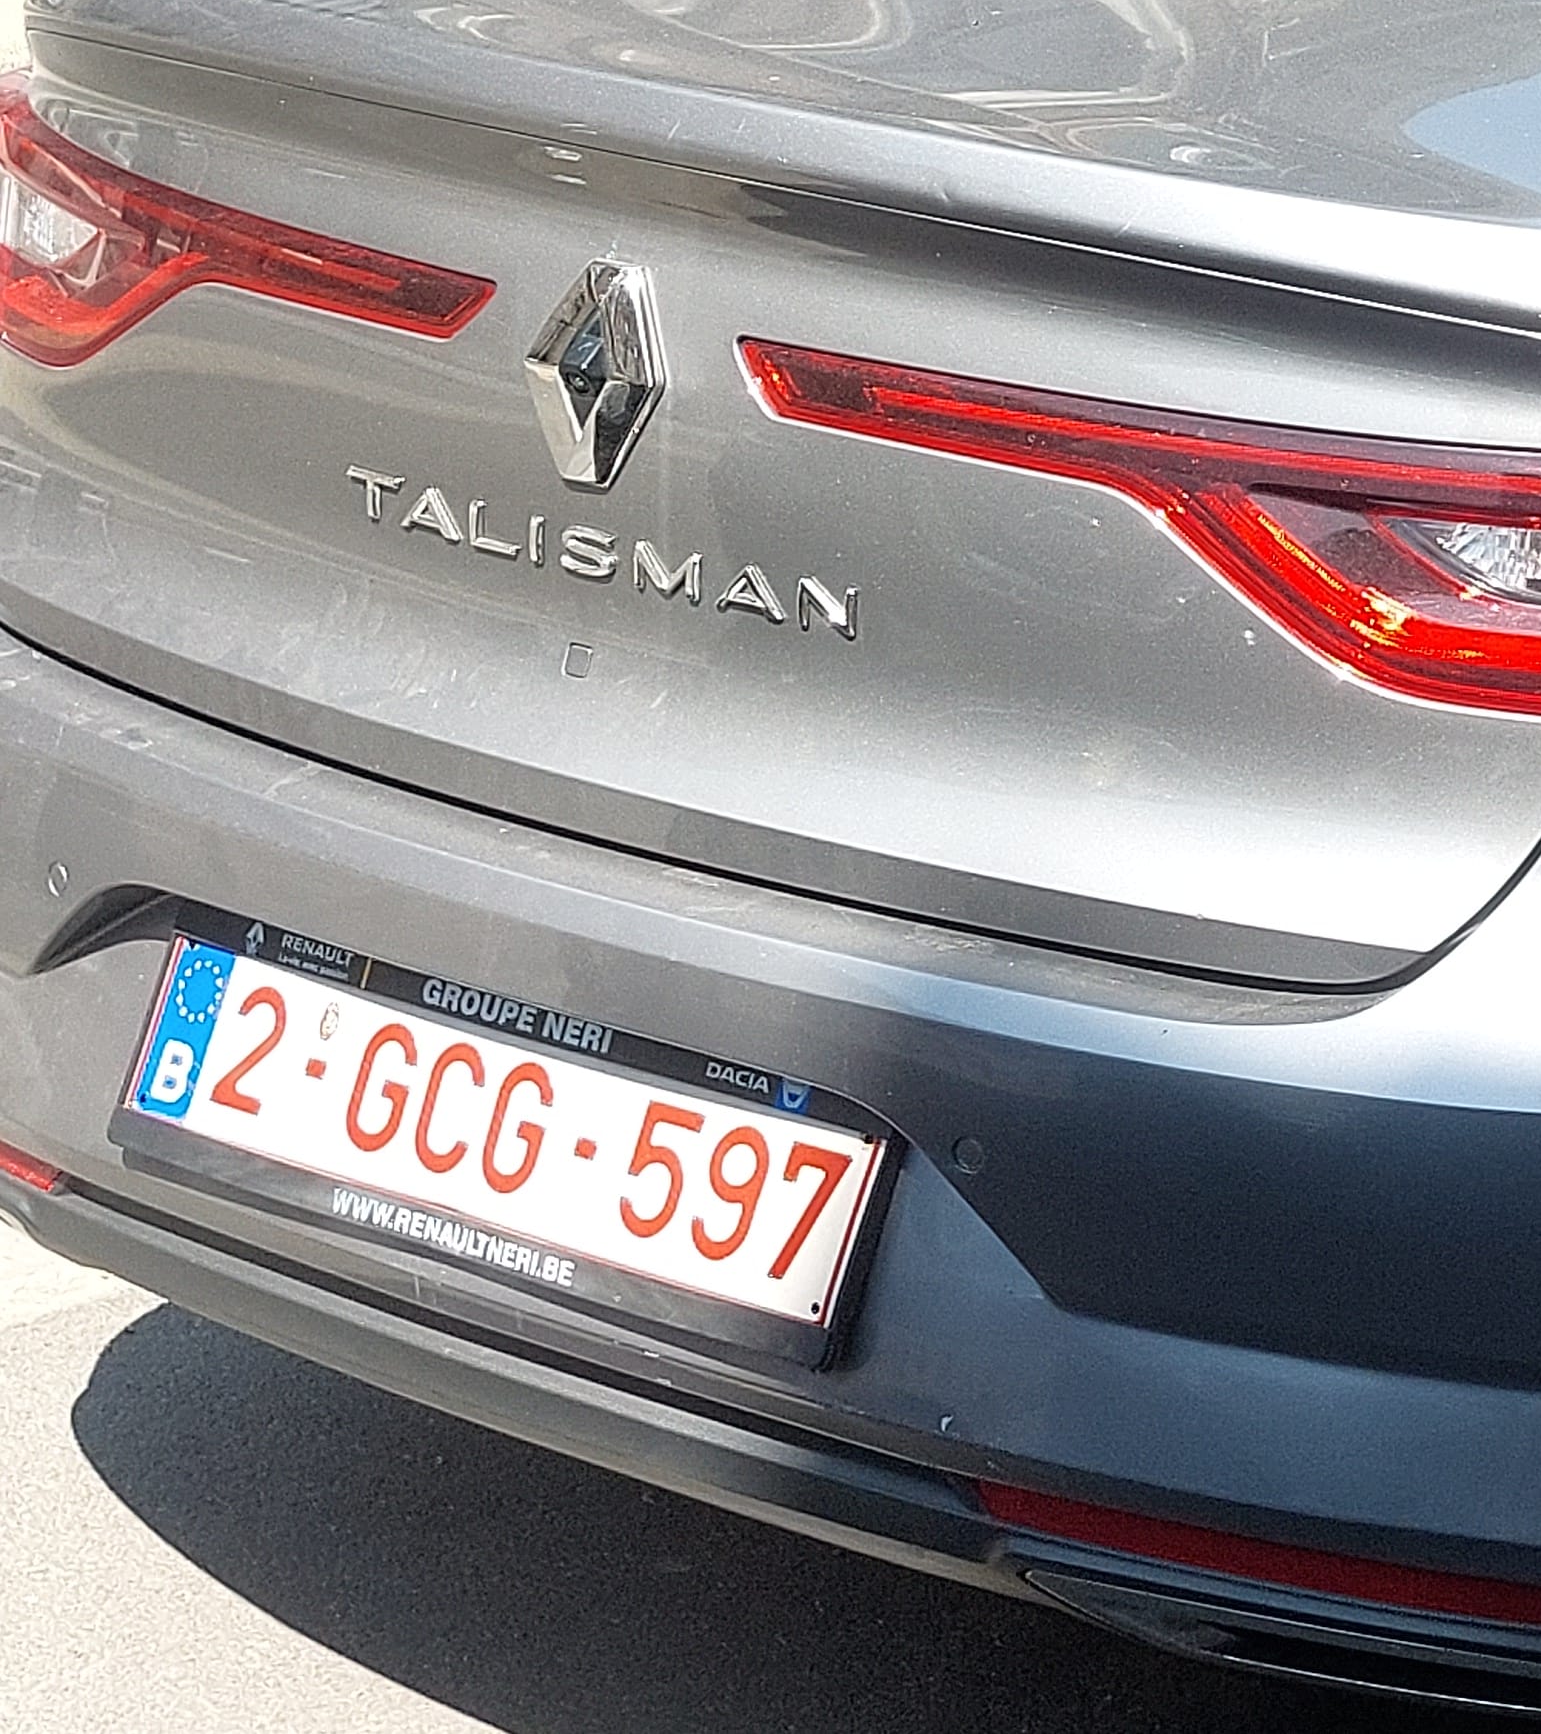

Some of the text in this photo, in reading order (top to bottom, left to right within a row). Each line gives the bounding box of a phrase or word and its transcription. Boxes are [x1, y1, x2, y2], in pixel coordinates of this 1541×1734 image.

[345, 464, 860, 641] TALISMAN
[281, 933, 355, 967] RENAULT
[422, 978, 614, 1055] GROUPE NERI
[151, 1039, 195, 1102] B
[705, 1061, 770, 1095] DACIA
[331, 1187, 577, 1288] WWW.RENAULTNERI.BE
